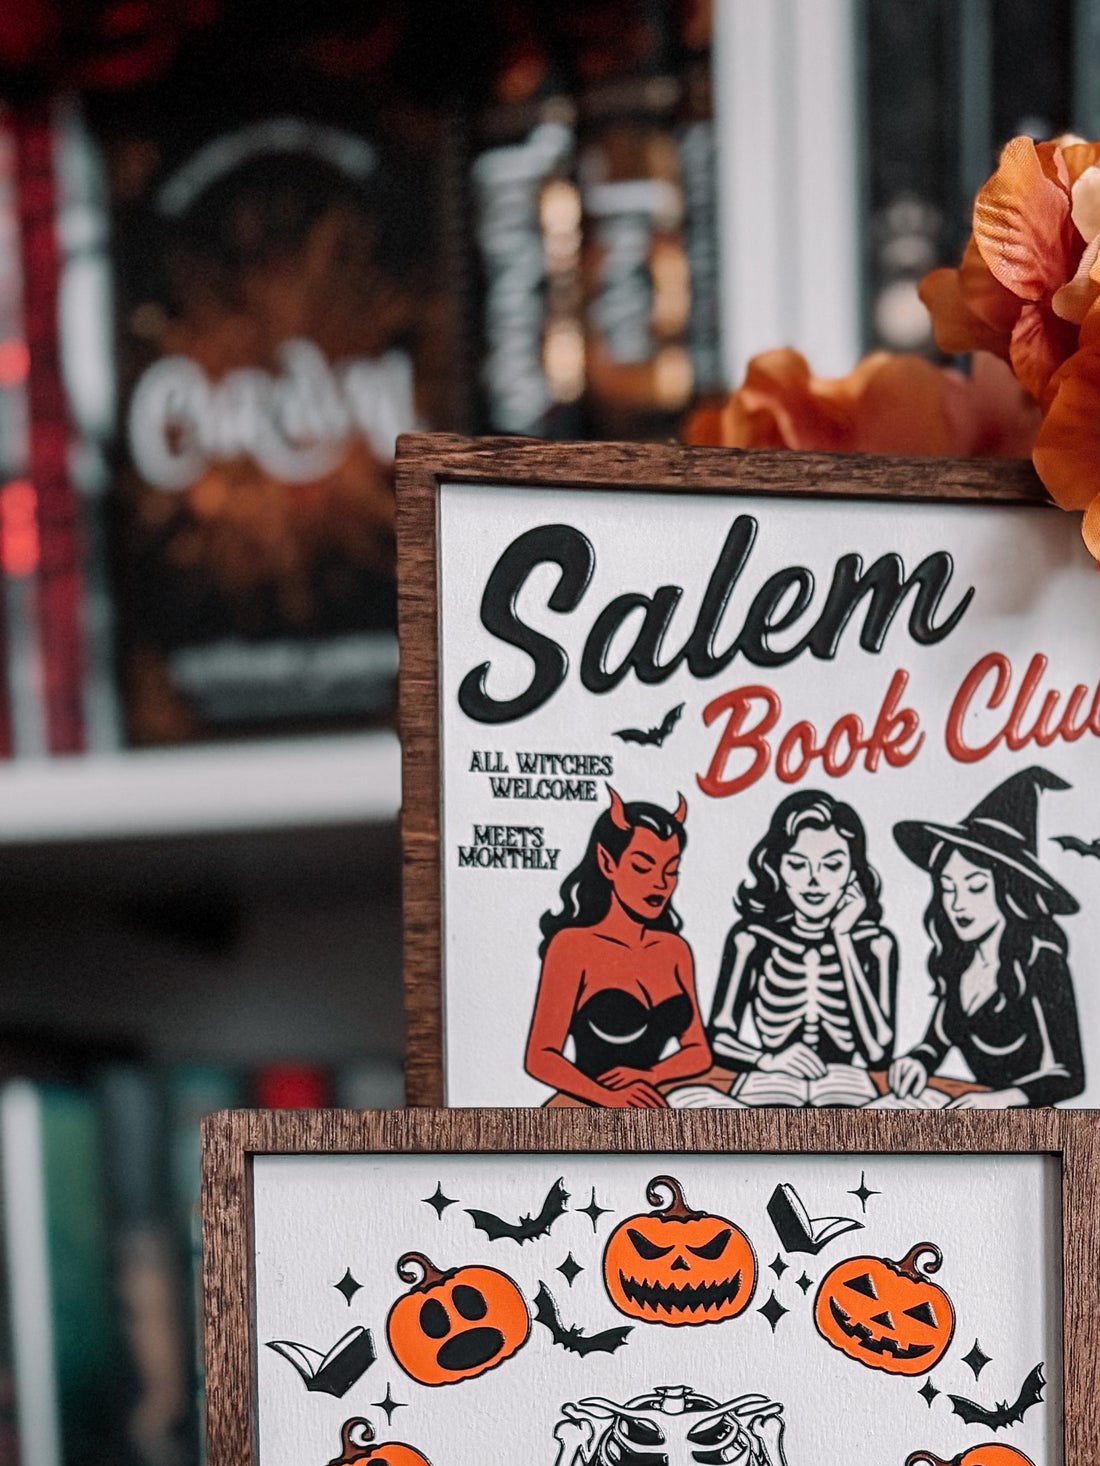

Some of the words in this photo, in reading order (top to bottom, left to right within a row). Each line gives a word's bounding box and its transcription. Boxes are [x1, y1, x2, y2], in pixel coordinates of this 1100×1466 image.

[458, 514, 975, 724] Salem
[696, 669, 925, 798] Book
[468, 751, 509, 773] ALL
[515, 752, 614, 777] WITCHES
[489, 777, 598, 802] WELCOME
[473, 824, 545, 848] MEETS
[457, 846, 562, 870] MONTHLY
